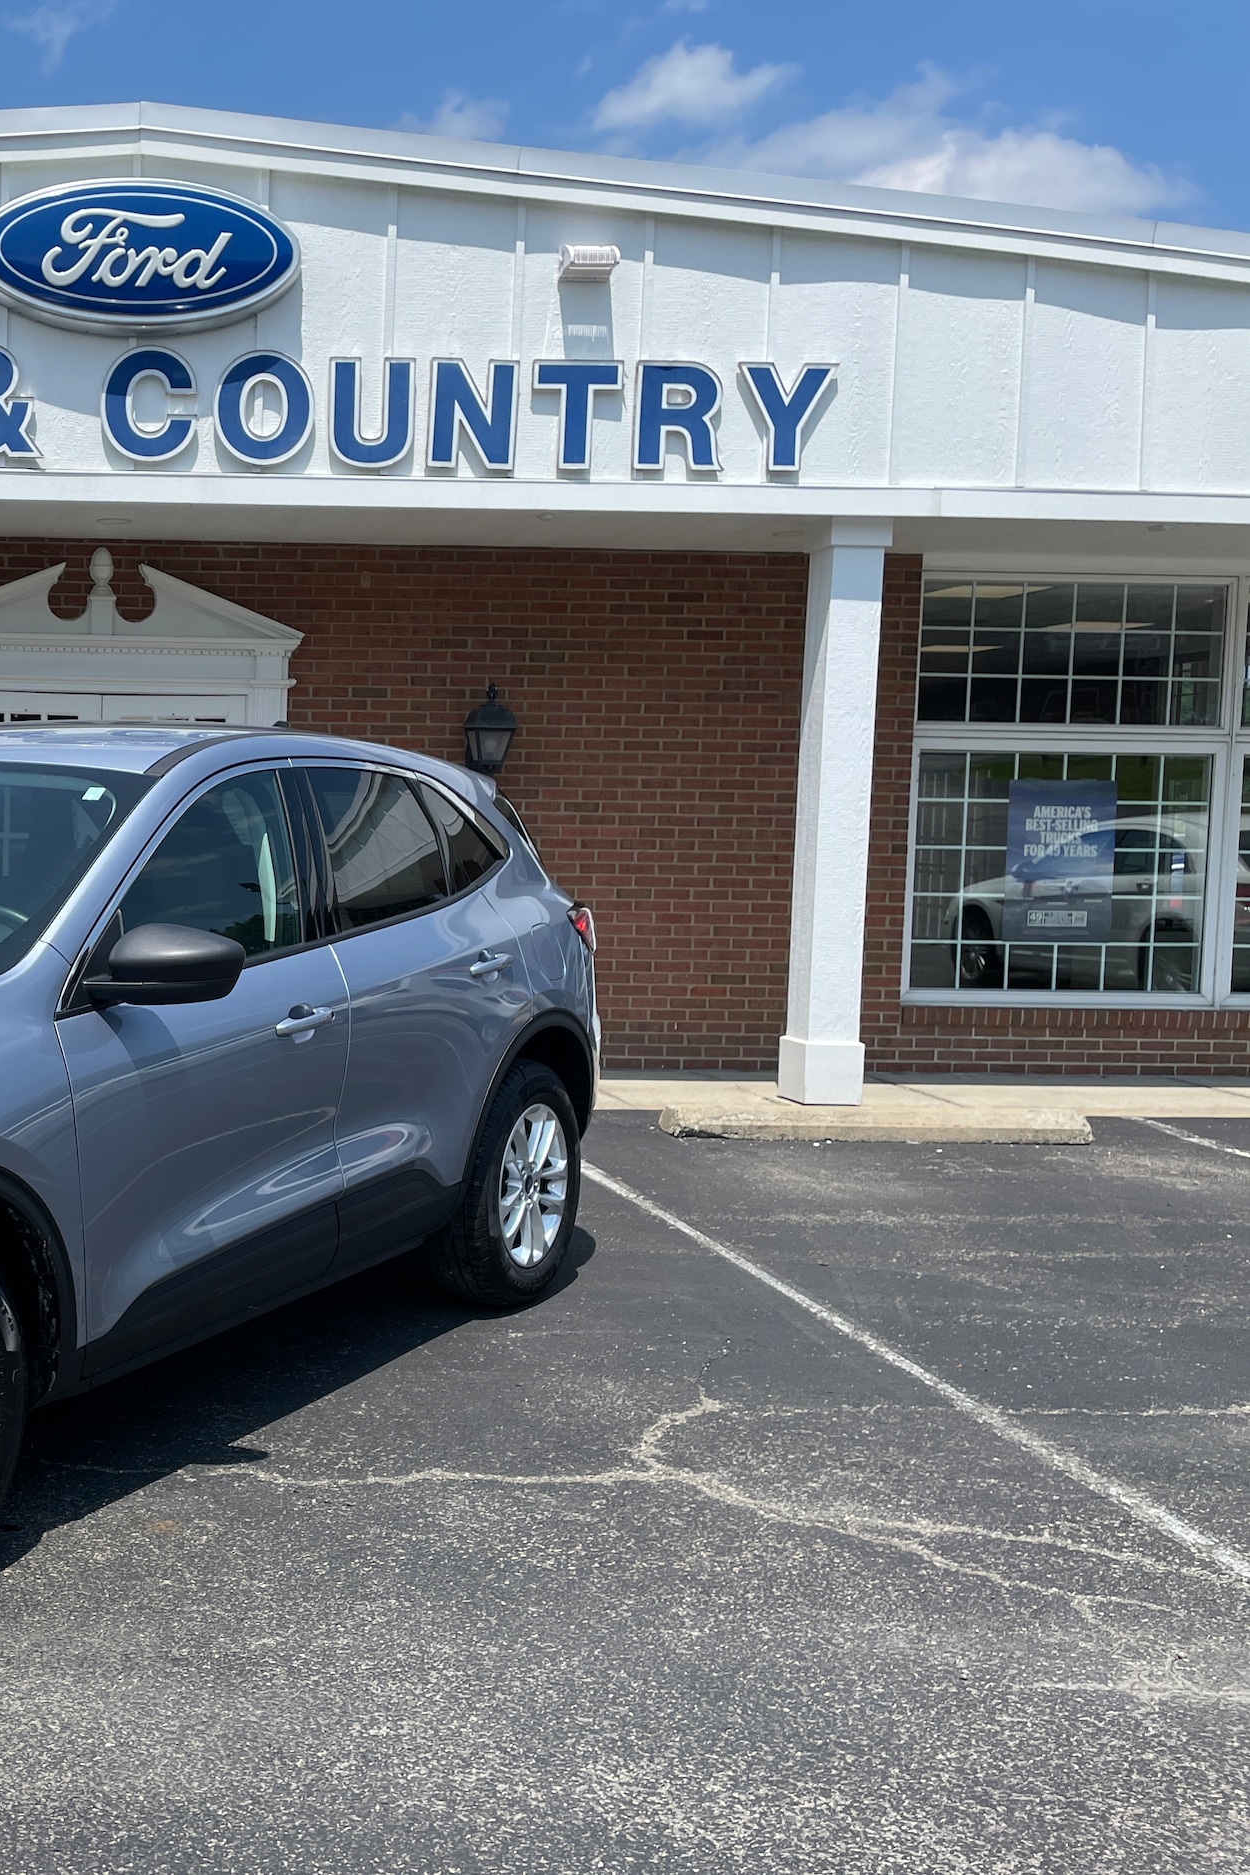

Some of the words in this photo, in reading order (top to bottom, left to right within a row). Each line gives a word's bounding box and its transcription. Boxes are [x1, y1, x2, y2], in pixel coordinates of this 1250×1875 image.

[41, 207, 233, 290] Ford
[100, 345, 839, 472] COUNTRY
[1033, 805, 1092, 818] AMERICA'S
[1025, 818, 1099, 832] BEST-SELLING
[1040, 831, 1082, 845] TRUCKS
[1023, 844, 1045, 857] FOR
[1046, 845, 1061, 857] 49
[1063, 845, 1098, 858] YEARS
